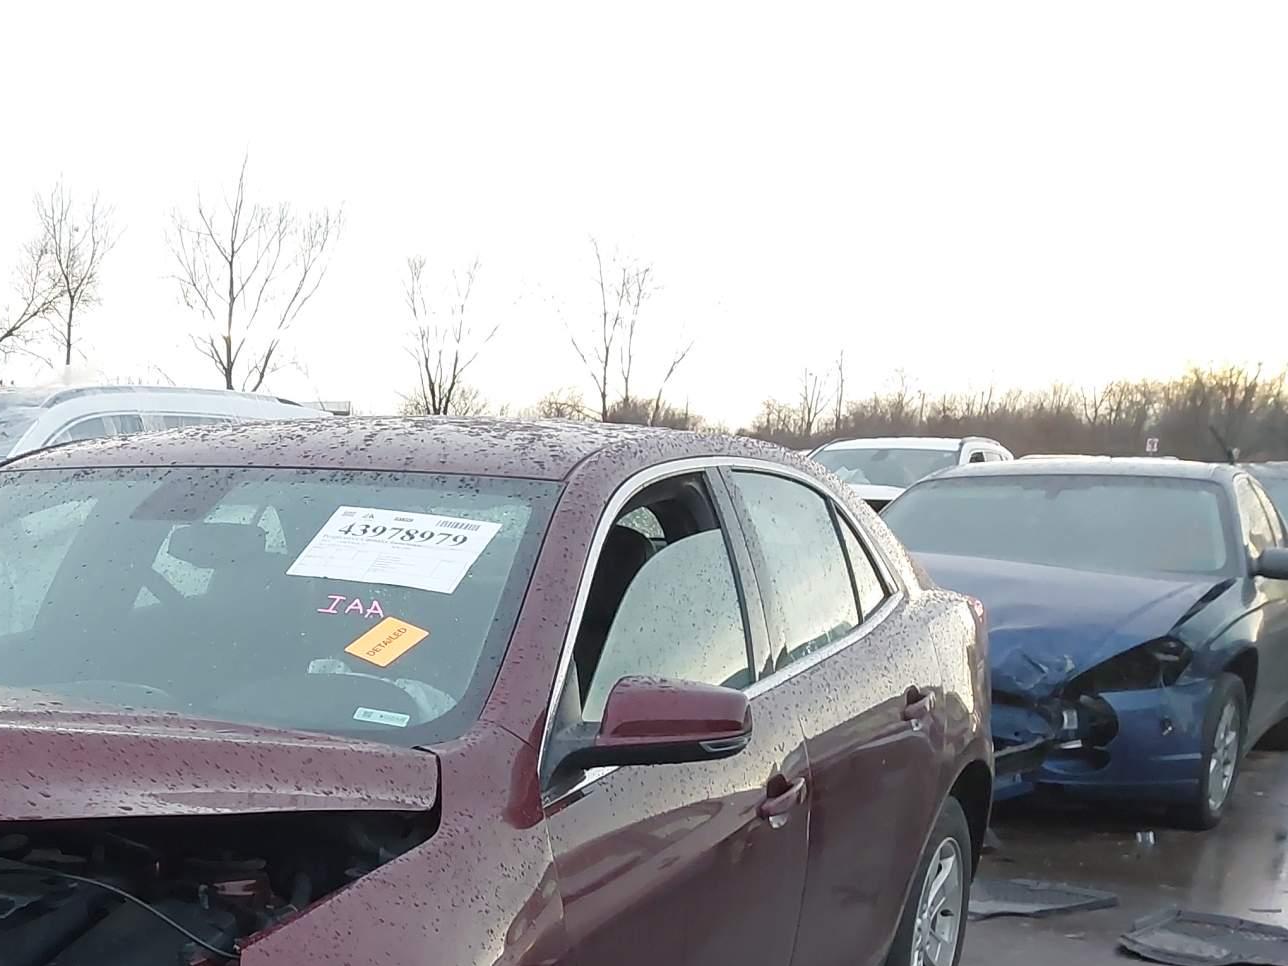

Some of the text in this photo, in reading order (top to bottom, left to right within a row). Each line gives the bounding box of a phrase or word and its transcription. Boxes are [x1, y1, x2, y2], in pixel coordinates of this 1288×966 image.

[338, 522, 468, 547] 43978979
[316, 595, 385, 618] IAA
[365, 626, 408, 657] DETAILED
